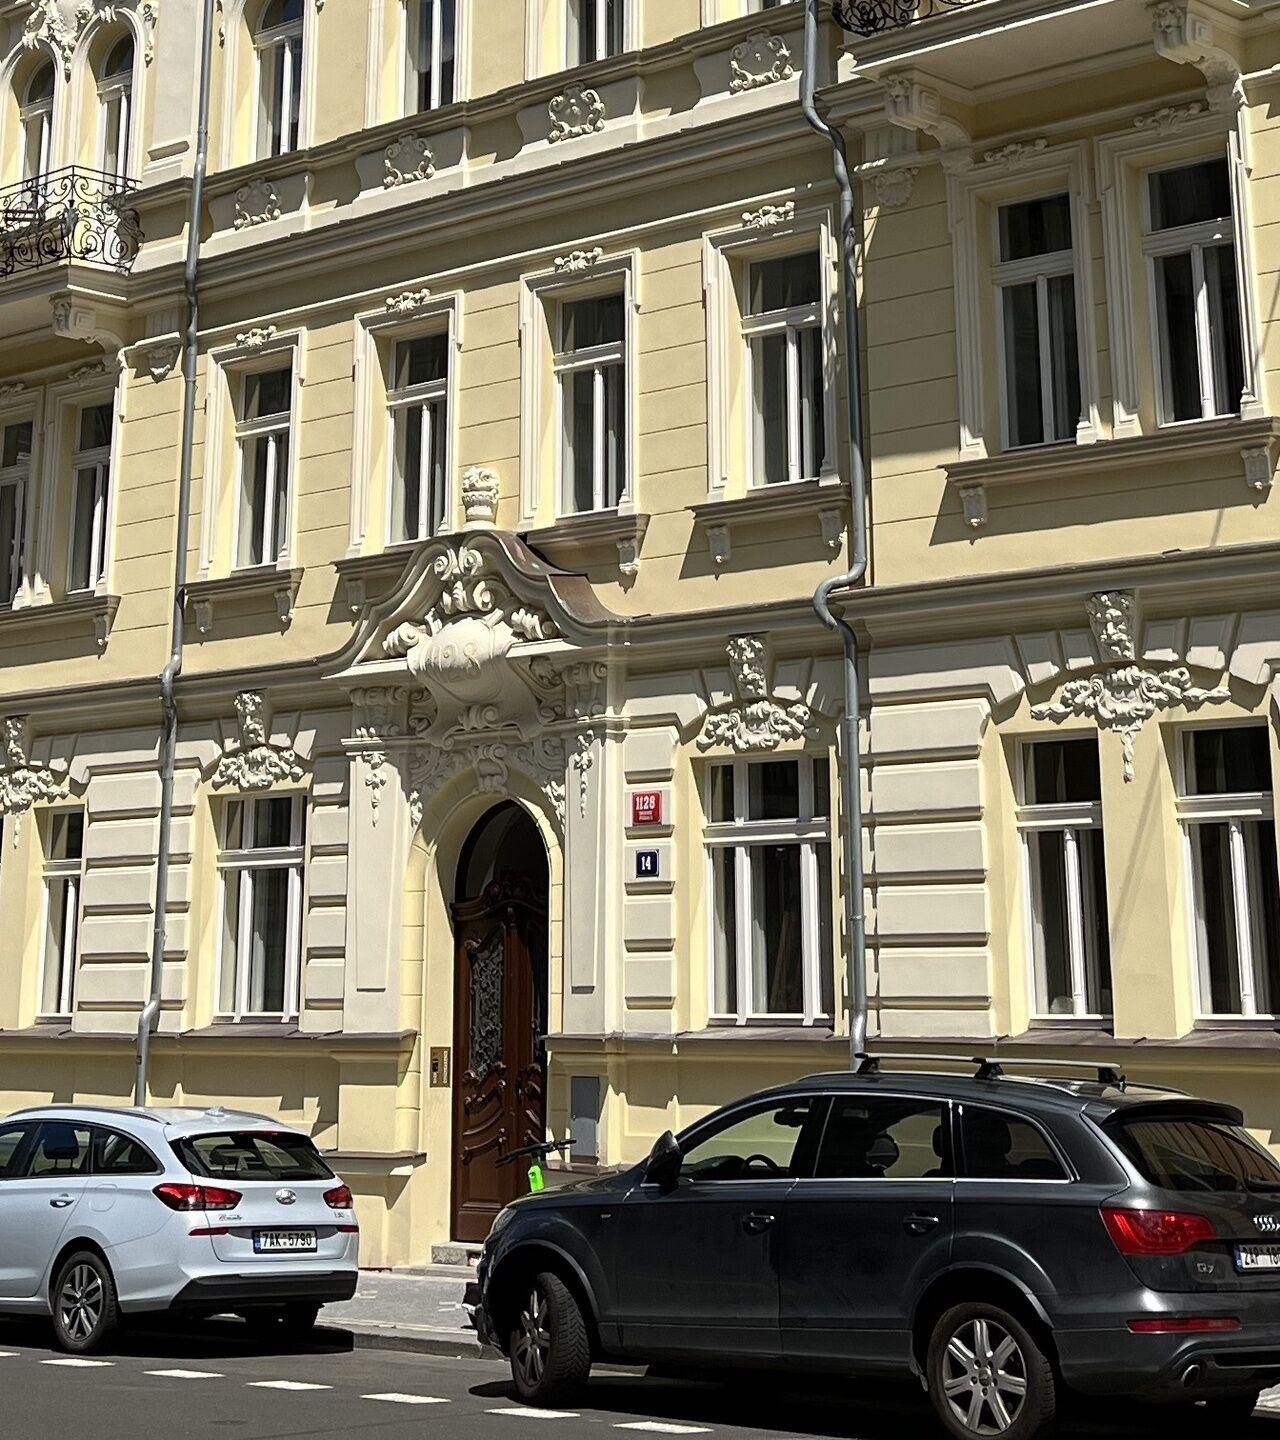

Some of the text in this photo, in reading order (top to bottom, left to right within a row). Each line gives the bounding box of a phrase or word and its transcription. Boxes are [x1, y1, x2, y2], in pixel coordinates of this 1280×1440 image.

[635, 795, 656, 810] 1128
[641, 856, 651, 871] 14
[262, 1232, 312, 1247] 7AK 5790
[1195, 1262, 1215, 1274] Q7
